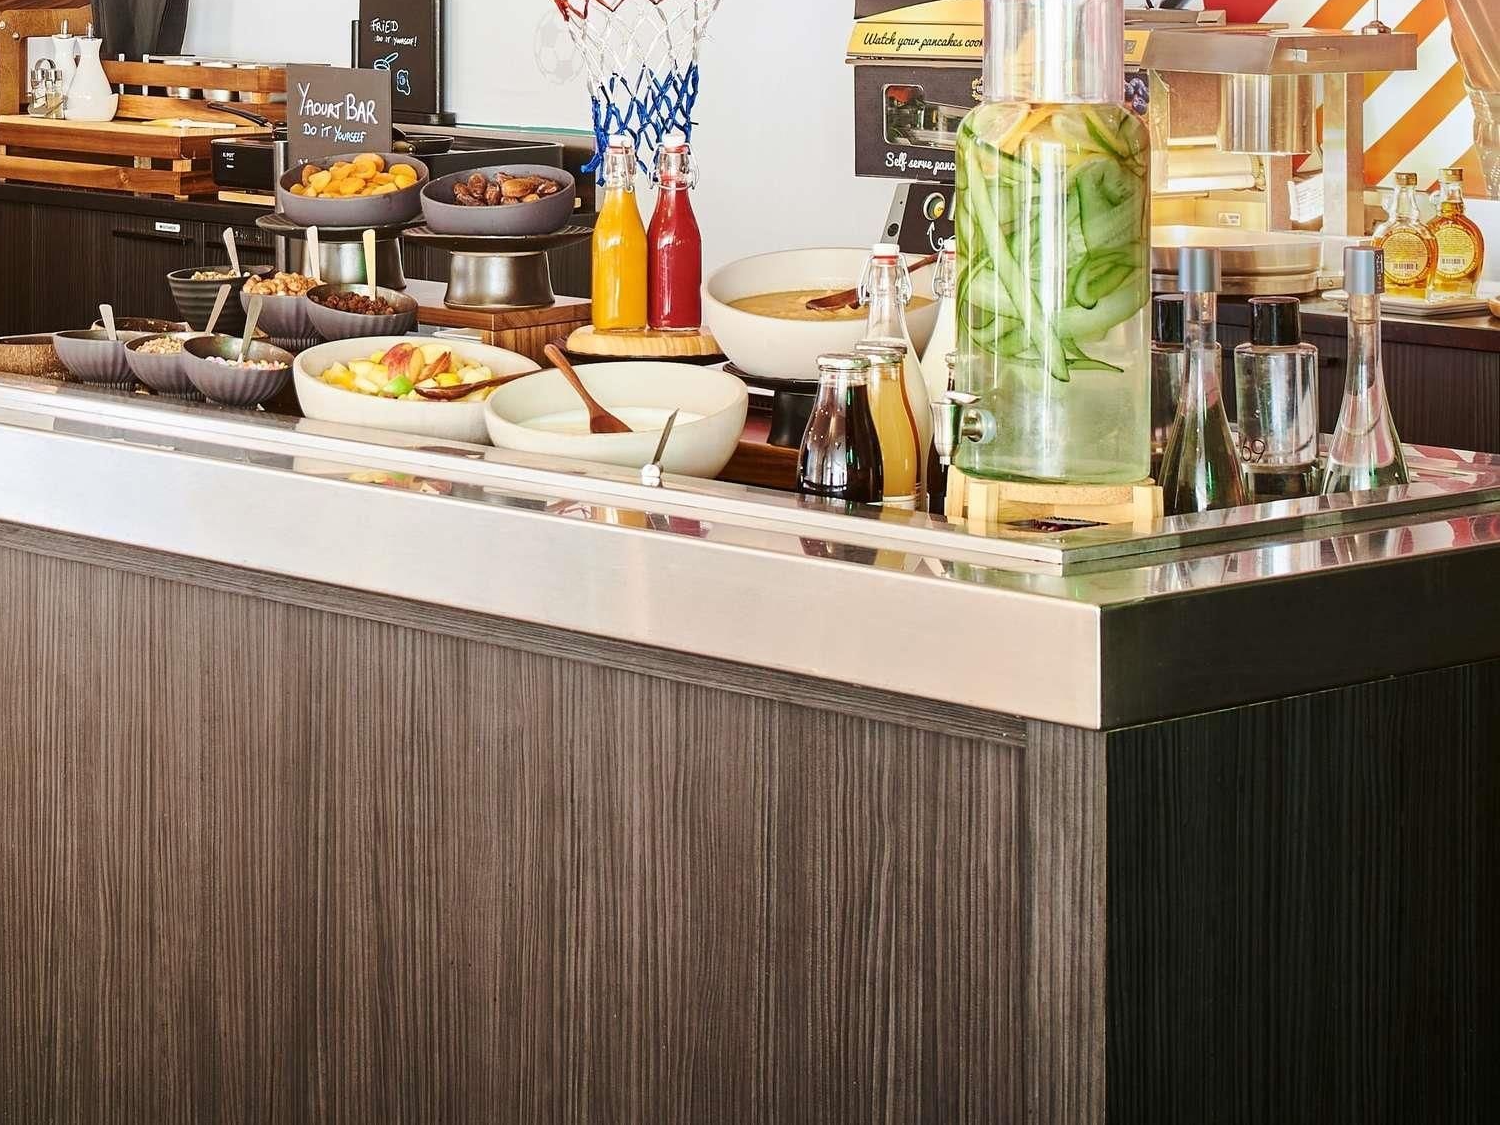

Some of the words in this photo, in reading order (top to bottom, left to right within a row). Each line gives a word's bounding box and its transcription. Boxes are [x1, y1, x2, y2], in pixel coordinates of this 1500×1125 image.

[863, 31, 898, 45] Watch
[897, 38, 921, 51] your
[921, 33, 963, 51] pancakes
[345, 92, 379, 125] BAR
[885, 151, 907, 172] Self
[908, 158, 933, 170] serve
